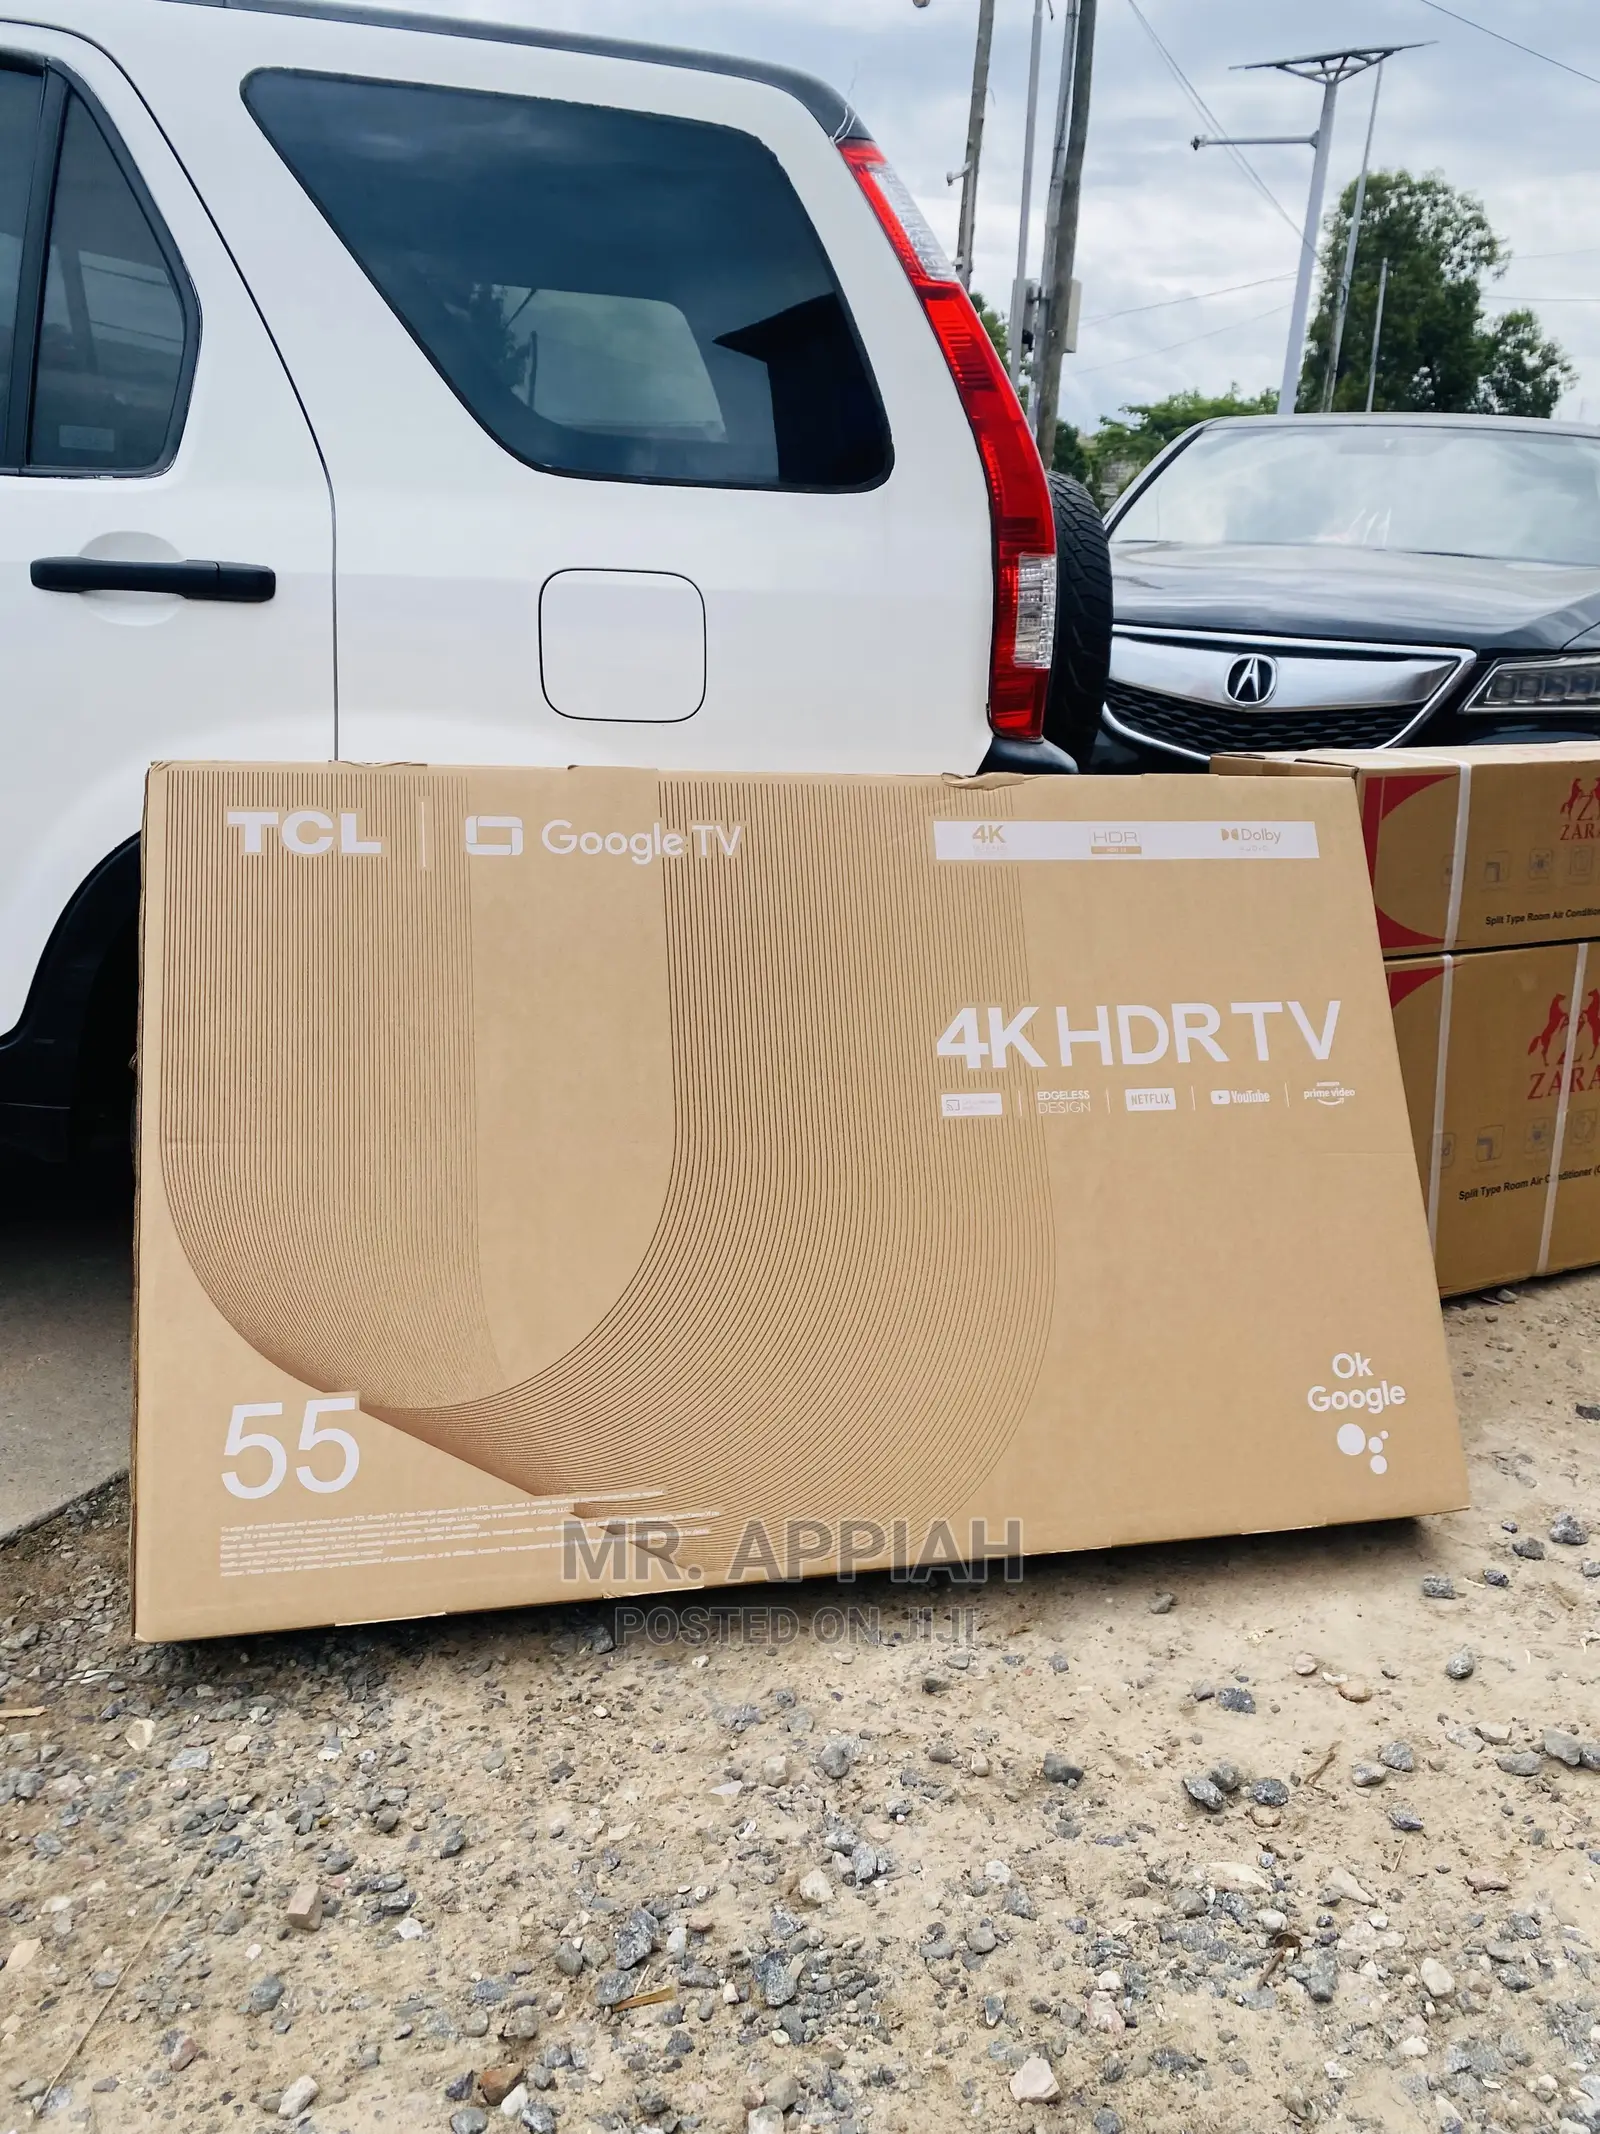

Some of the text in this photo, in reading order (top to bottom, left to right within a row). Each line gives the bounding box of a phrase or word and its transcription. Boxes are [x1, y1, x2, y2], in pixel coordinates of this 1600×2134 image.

[226, 810, 383, 855] TCL
[972, 824, 1007, 844] 4K
[1092, 830, 1138, 844] HDR
[1241, 828, 1281, 844] Dolby
[1559, 822, 1600, 841] ZAR
[540, 818, 742, 865] Google TV
[1485, 916, 1504, 926] Split
[1506, 914, 1525, 925] Type
[1527, 912, 1550, 921] Room
[1552, 911, 1564, 920] Air
[936, 1001, 1342, 1069] 4K HDR TV
[1036, 1090, 1090, 1101] EDGELESS
[1131, 1093, 1171, 1106] NETFLIX
[1231, 1089, 1270, 1104] YouTube
[1303, 1087, 1356, 1100] prime video
[1037, 1101, 1091, 1114] DESIGN
[1459, 1189, 1478, 1201] Split
[1481, 1186, 1501, 1198] Type
[1503, 1180, 1529, 1191] Room
[1530, 1177, 1543, 1186] Air
[1545, 1168, 1592, 1183] Cnditioner
[1332, 1352, 1374, 1379] Ok
[1307, 1380, 1407, 1414] Google
[221, 1398, 359, 1499] 55
